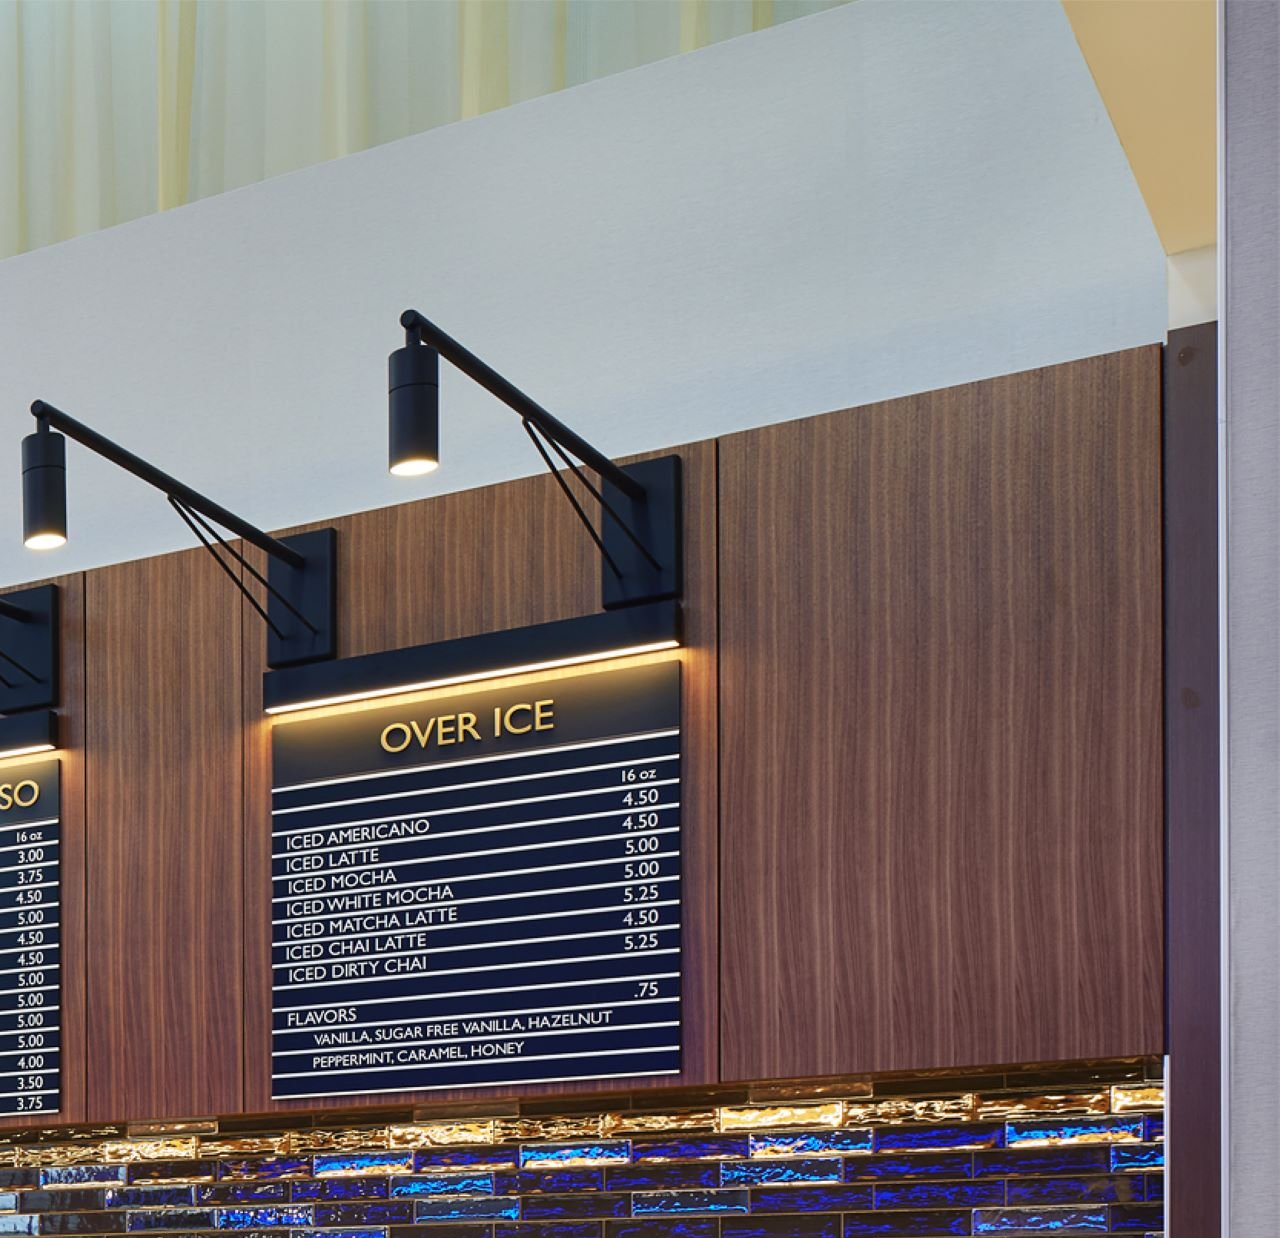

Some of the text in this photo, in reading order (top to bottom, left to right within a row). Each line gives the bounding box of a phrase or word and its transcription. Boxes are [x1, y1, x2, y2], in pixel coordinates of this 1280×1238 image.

[380, 699, 555, 753] OVER ICE
[286, 789, 658, 851] ICED AMERICANO 4.50
[286, 813, 658, 873] ICED LATTE 4.50
[18, 848, 43, 864] 3.00
[288, 837, 658, 895] ICED MOCHA 5.00
[17, 869, 42, 884] 3.75
[16, 889, 42, 905] 4.50
[286, 861, 659, 917] ICED WHITE MOCHA 5.00
[17, 910, 43, 925] 5.00
[286, 885, 658, 939] ICED MATCHA LATTE 5.25
[17, 931, 43, 946] 4.50
[286, 909, 659, 961] ICED CHAI LATTE 4.50
[17, 951, 43, 966] 4.50
[288, 934, 658, 983] ICED DIRTY CHAI 5.25
[18, 972, 43, 987] 5.00
[17, 993, 43, 1007] 5.00
[287, 982, 658, 1027] FLAVORS .75
[17, 1013, 43, 1028] 5.00
[314, 1011, 612, 1048] VANILLA, SUGAR FREE VANILLA, HAZELNUT
[17, 1034, 43, 1048] 5.00
[17, 1055, 43, 1069] 4.00
[312, 1041, 524, 1070] PEPPERMINT, CARAMEL, HONEY
[17, 1075, 43, 1090] 3.50
[16, 1096, 42, 1110] 3.75
